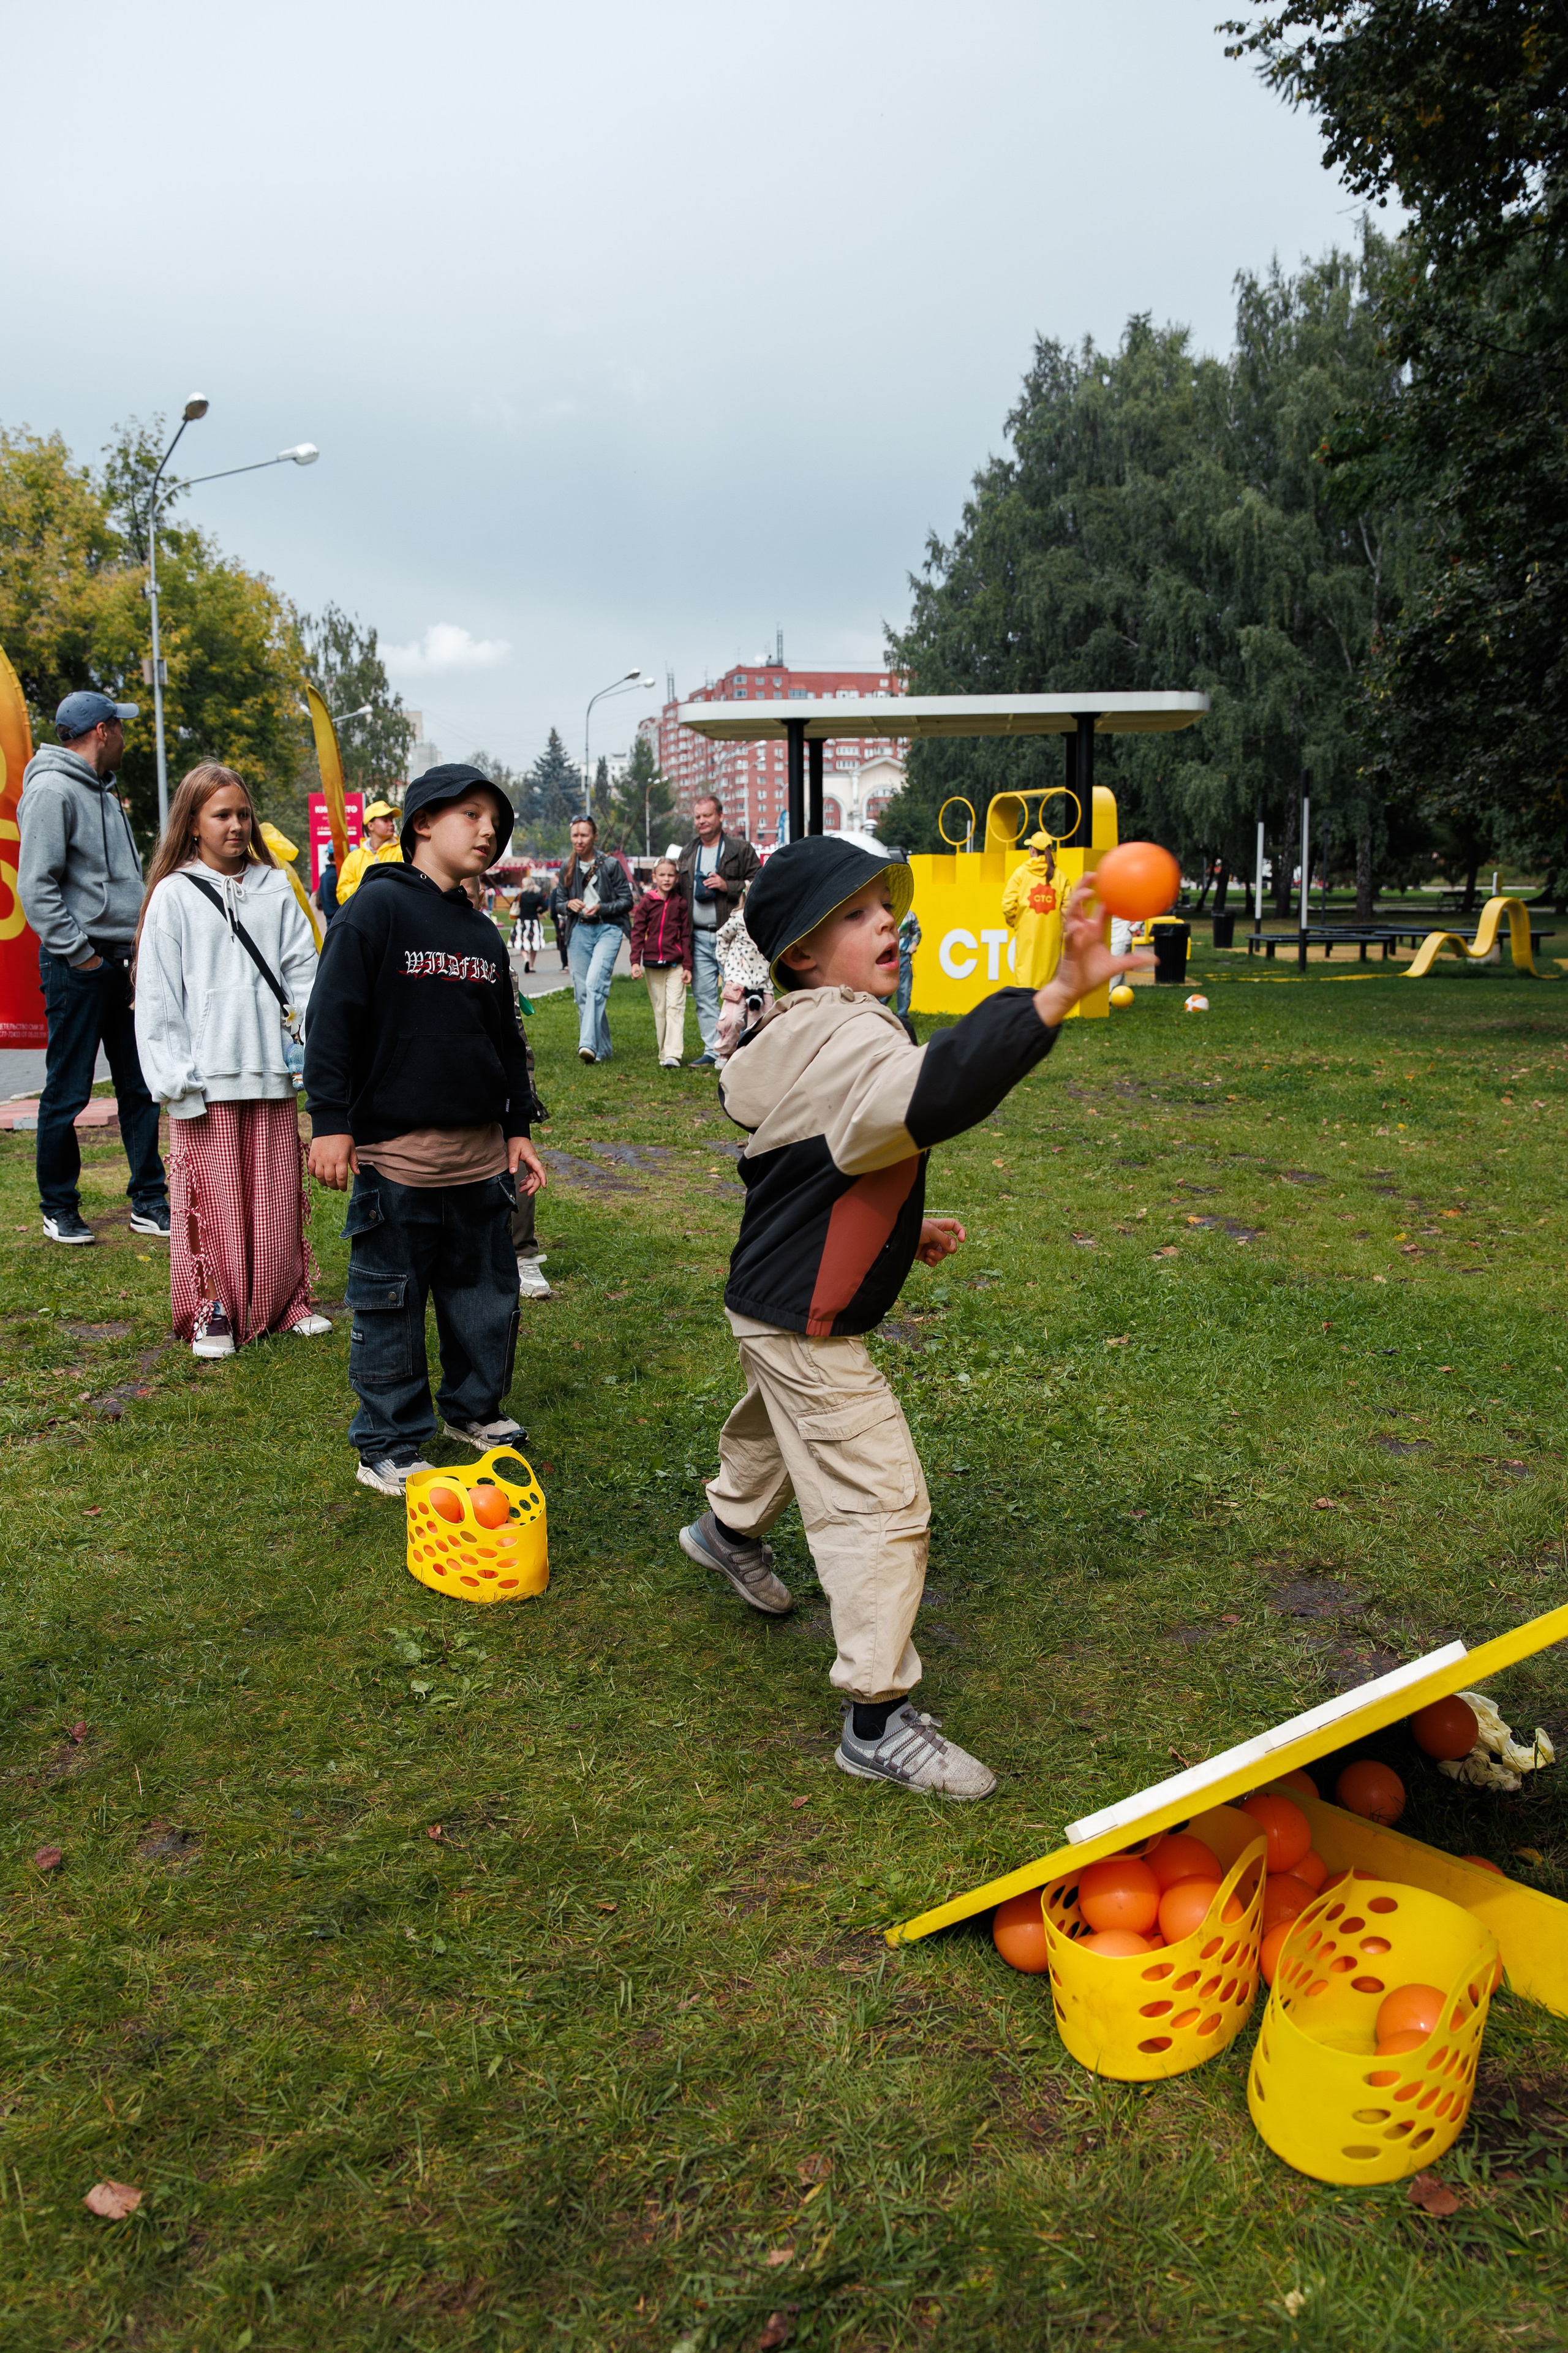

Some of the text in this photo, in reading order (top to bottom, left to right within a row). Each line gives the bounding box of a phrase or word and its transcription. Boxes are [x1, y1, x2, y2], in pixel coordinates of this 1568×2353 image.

[1033, 894, 1052, 903] СТС
[405, 951, 496, 983] WILDFIRE
[939, 928, 1016, 981] СТ
